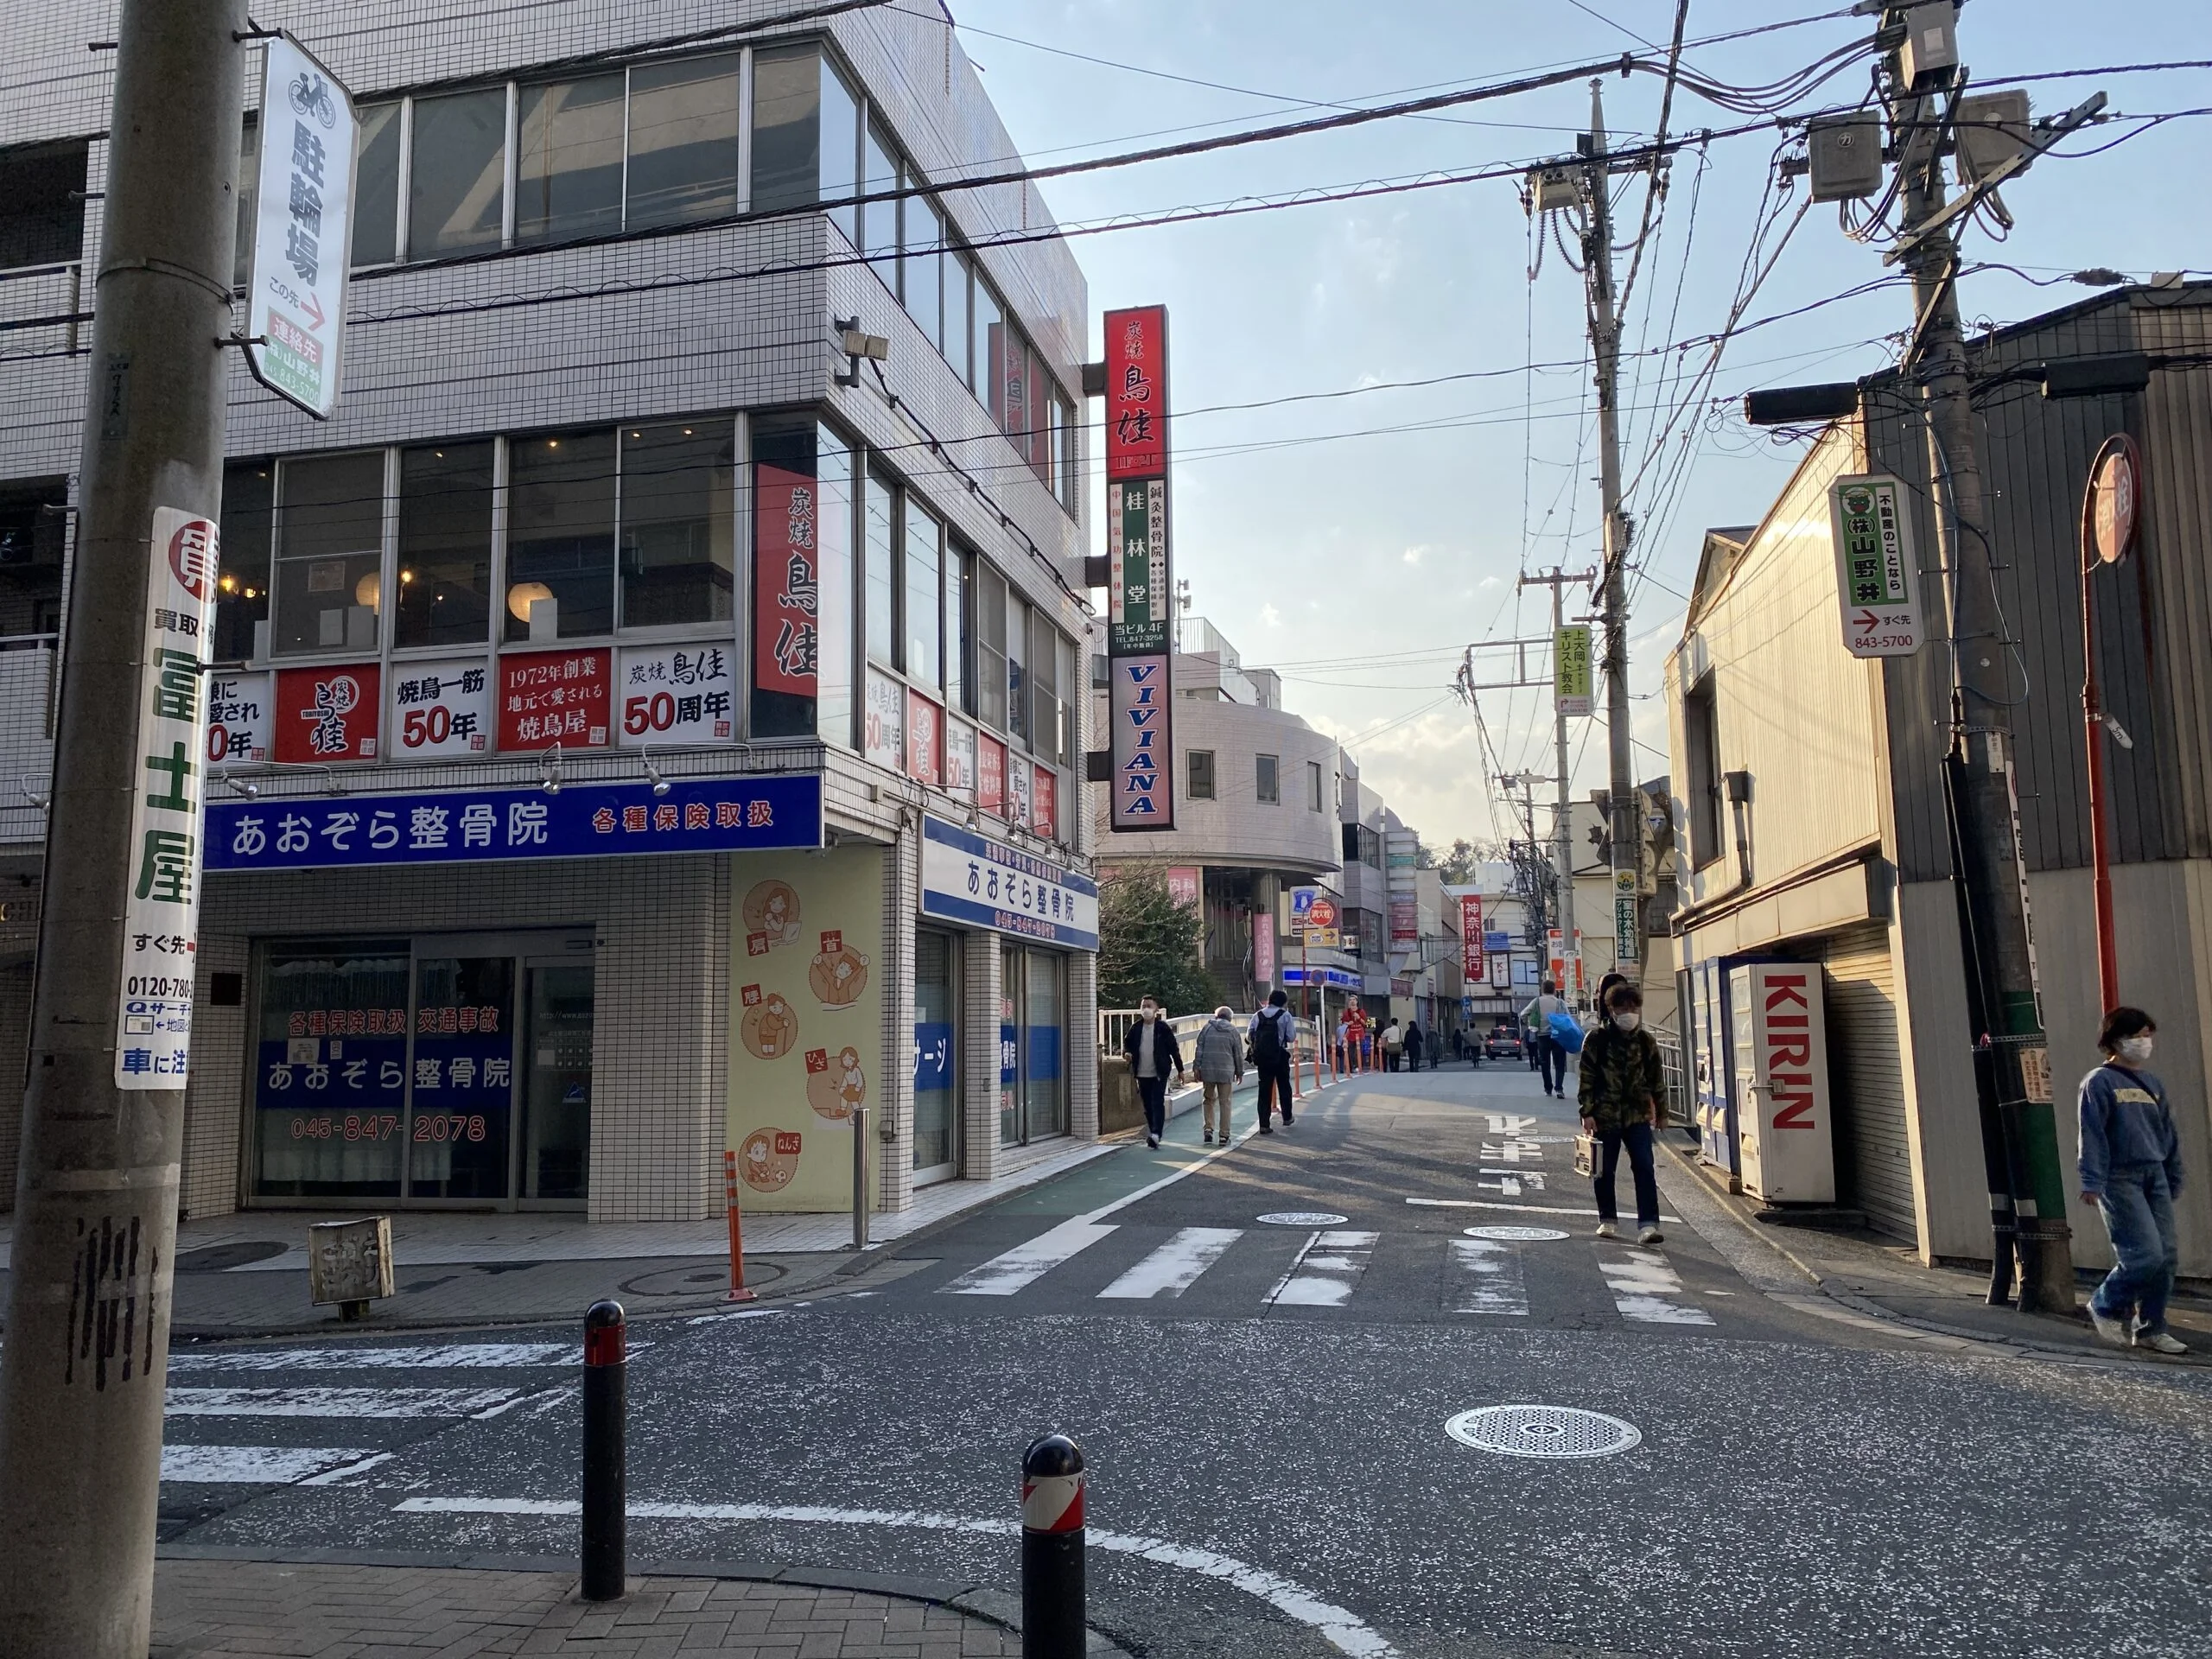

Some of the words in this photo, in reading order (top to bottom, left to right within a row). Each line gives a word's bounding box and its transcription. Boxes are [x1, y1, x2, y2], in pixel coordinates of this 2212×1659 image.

[285, 118, 326, 286] 駐輪場
[270, 276, 299, 308] この先
[274, 317, 316, 363] 連絡先
[1126, 491, 1147, 605] 桂林堂
[1879, 494, 1901, 591] 不動産のことなら
[1115, 623, 1147, 637] 当ビル
[1149, 621, 1164, 633] 4F
[1883, 614, 1911, 626] すぐ先
[1574, 630, 1585, 662] 上大岡
[1855, 635, 1913, 648] 843-5700
[509, 656, 596, 689] 1972年創業
[1560, 630, 1573, 694] キリスト教会
[397, 668, 484, 705] 焼鳥一筋
[507, 683, 602, 713] 地元で愛される
[403, 704, 478, 748] 50年
[518, 709, 587, 742] 焼鳥屋
[624, 690, 730, 735] 50周年
[1122, 663, 1161, 817] VIVIANA
[232, 800, 549, 855] あおぞら整骨院
[593, 800, 773, 834] 各種保険取扱
[968, 860, 1074, 922] あおぞら整骨院
[1169, 878, 1195, 891] 内科
[1311, 909, 1331, 918] 消火栓
[132, 933, 185, 955] すぐ先
[750, 938, 766, 955] 肩
[823, 937, 840, 952] 首
[1465, 902, 1481, 971] 神奈川銀行
[289, 1009, 406, 1035] 各種保険取扱
[417, 1006, 499, 1034] 交通事故
[122, 1047, 188, 1076] 車に注
[806, 1052, 825, 1071] ひざ
[1001, 1040, 1015, 1069] 骨院
[1764, 975, 1815, 1129] KIRIN
[269, 1057, 511, 1090] あおぞら整骨院
[290, 1115, 486, 1142] 045-847-2078
[778, 1136, 799, 1151] ねんざ
